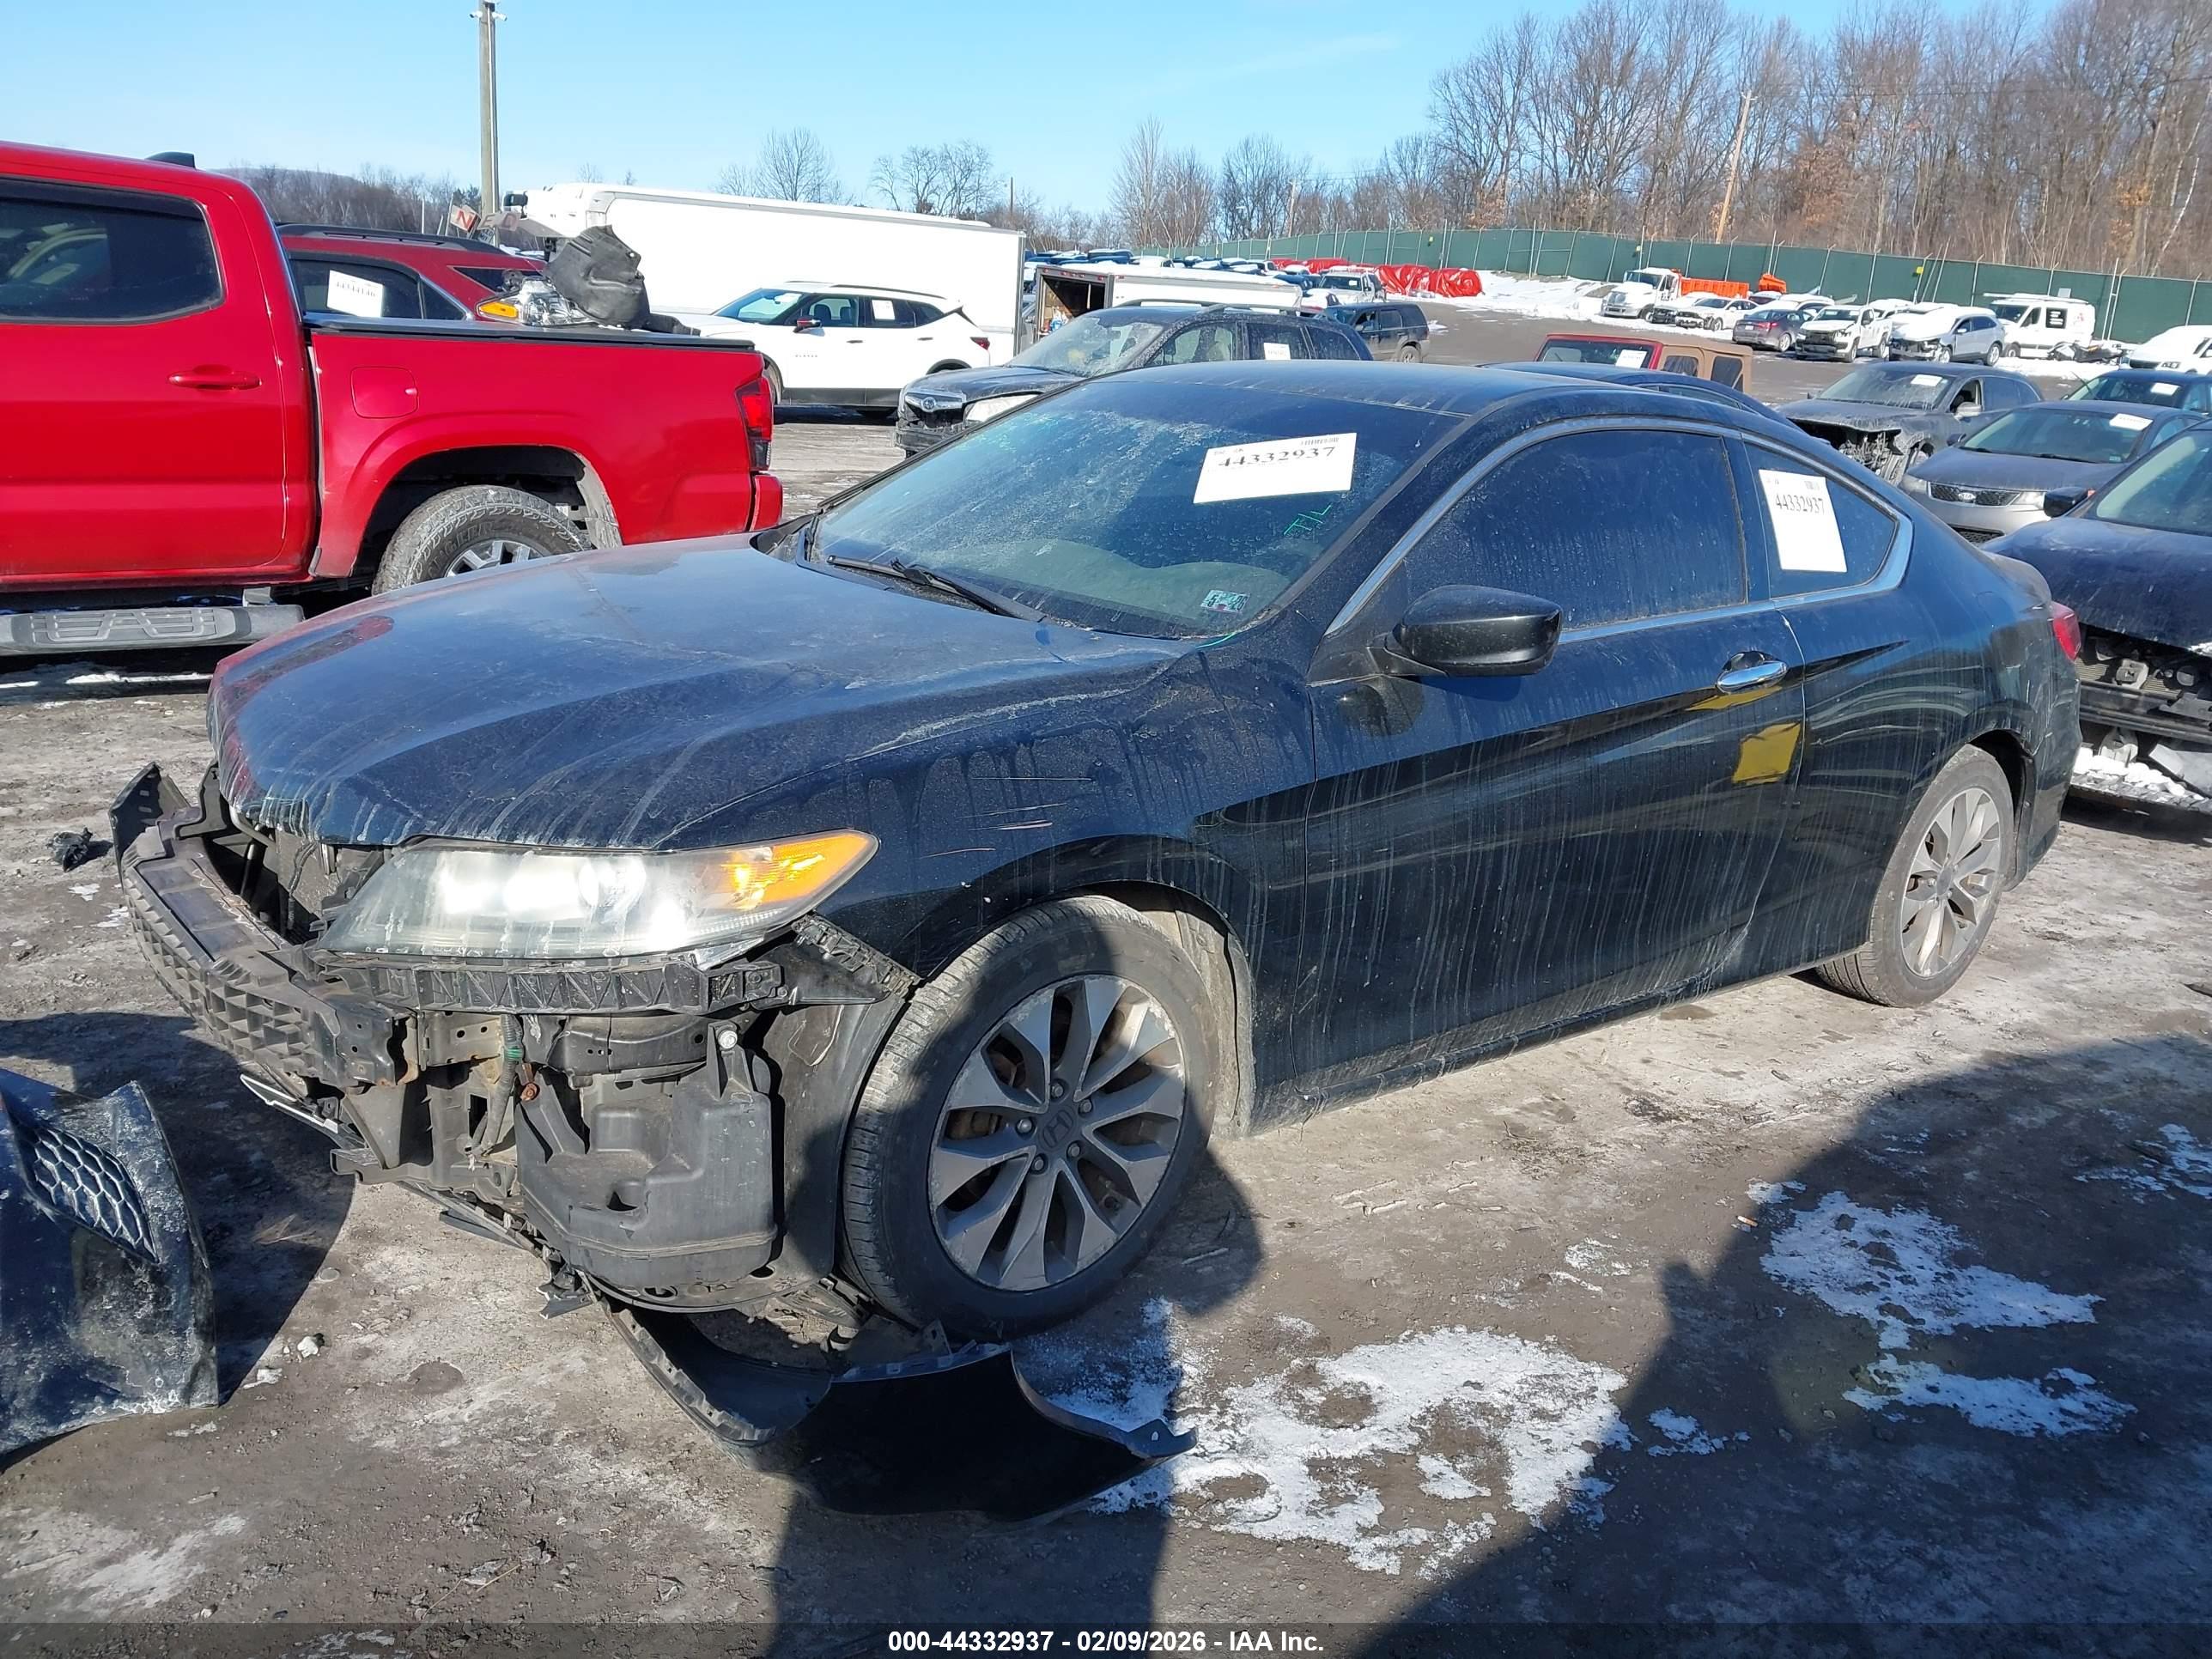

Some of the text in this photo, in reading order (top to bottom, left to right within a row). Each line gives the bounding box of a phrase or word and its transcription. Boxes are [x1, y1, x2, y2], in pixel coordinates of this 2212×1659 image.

[456, 209, 477, 229] N
[1218, 447, 1336, 467] 44332937
[1775, 492, 1825, 515] 44332937
